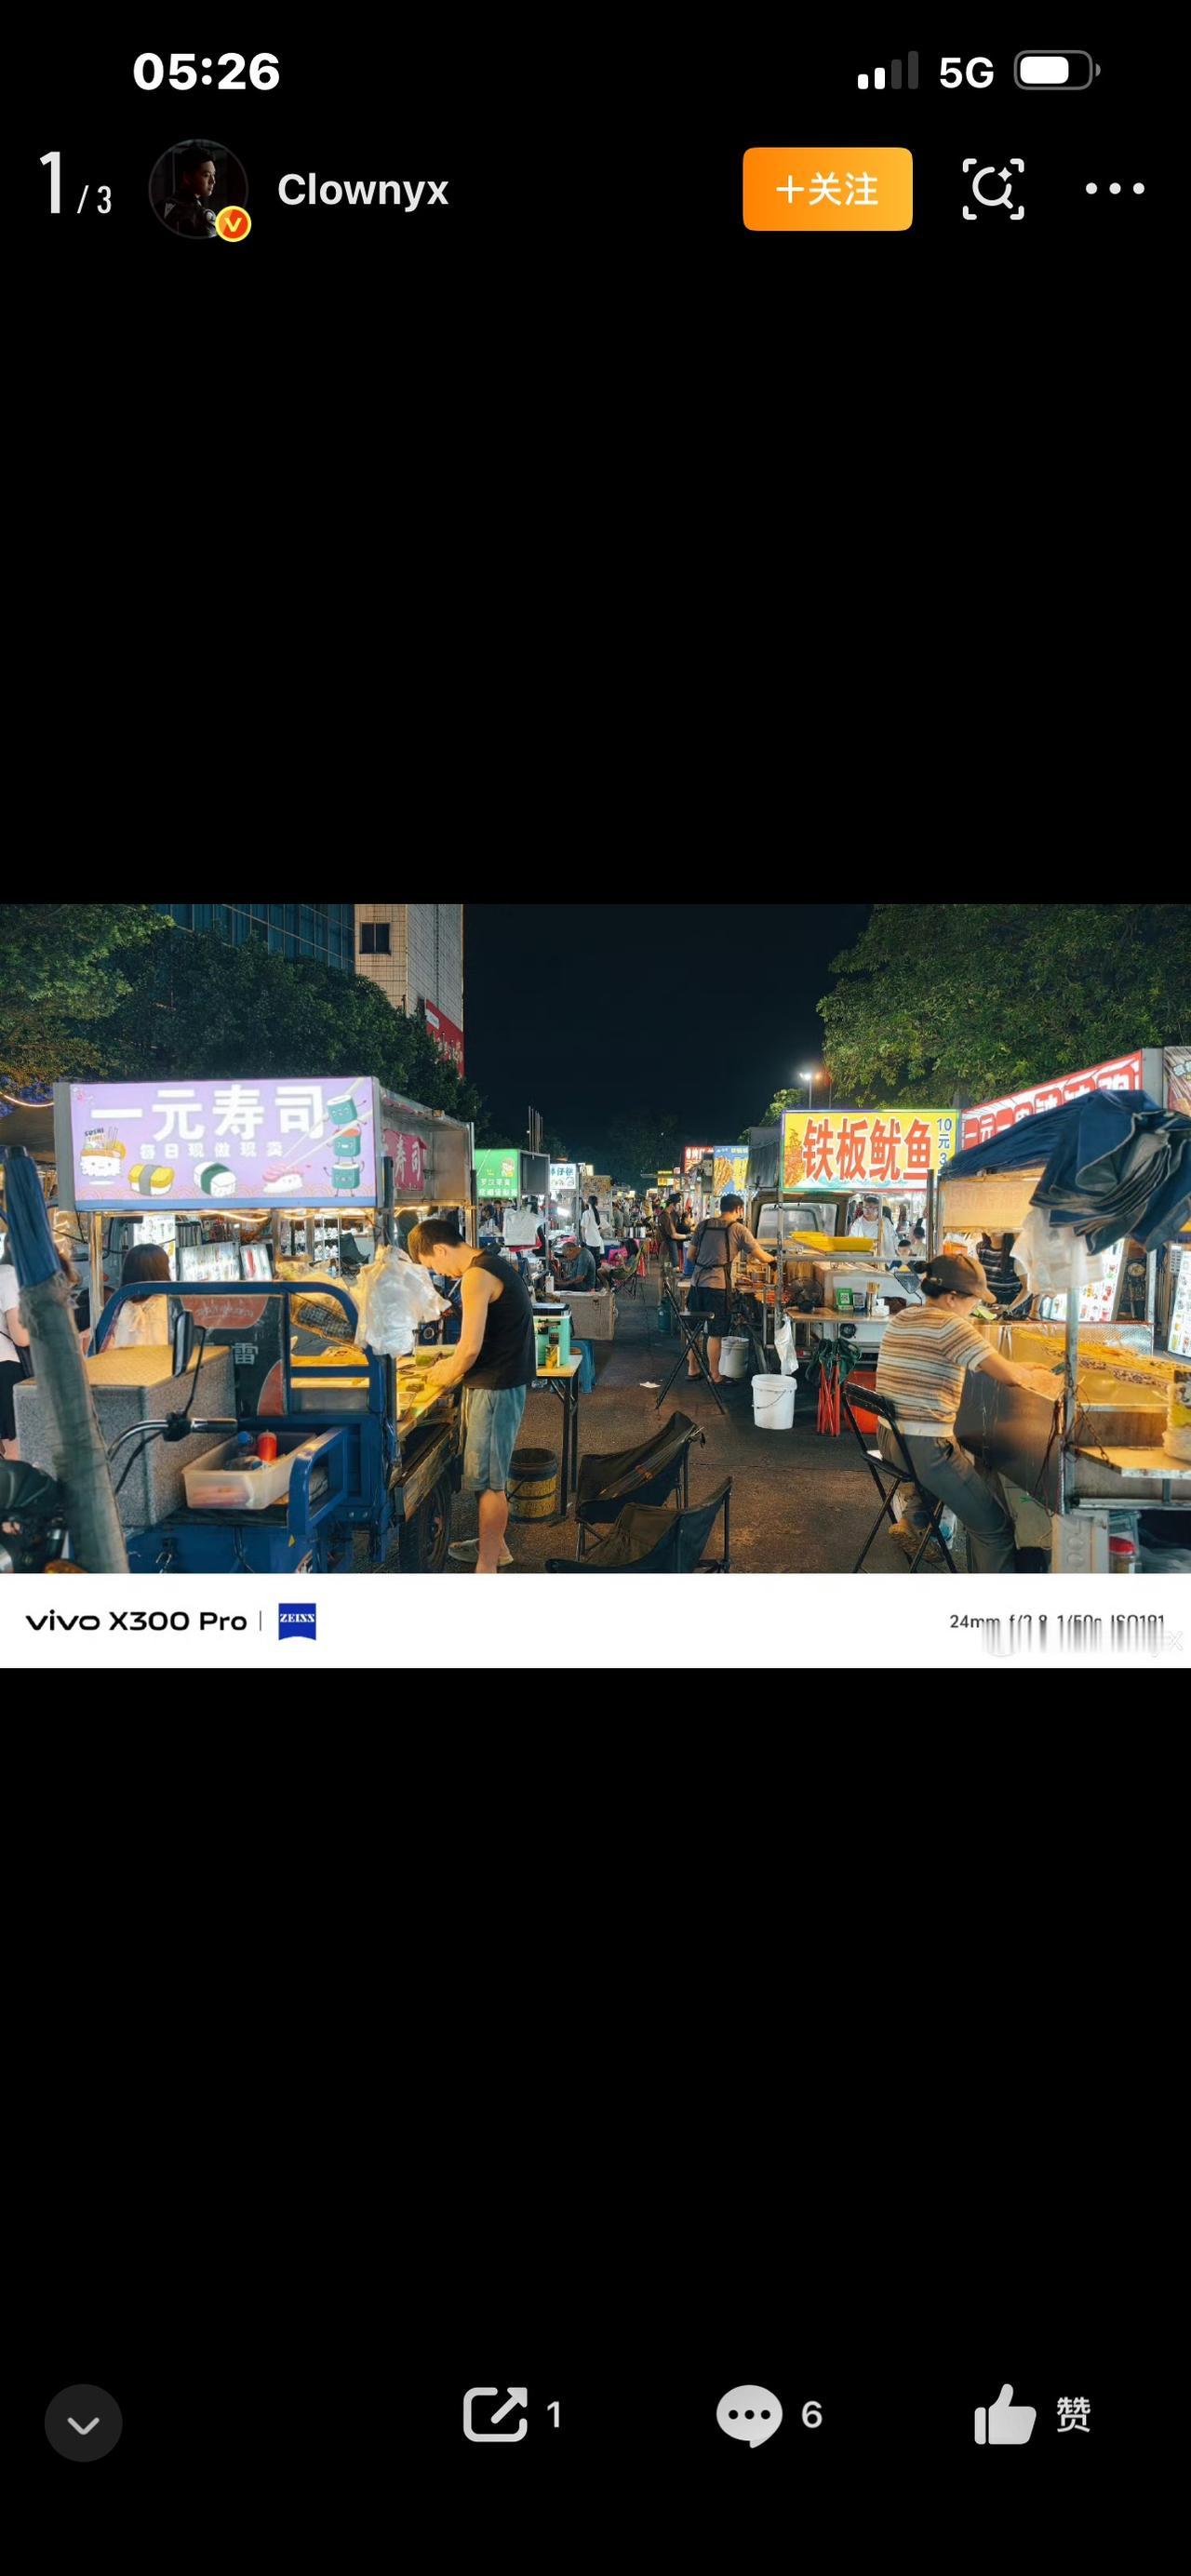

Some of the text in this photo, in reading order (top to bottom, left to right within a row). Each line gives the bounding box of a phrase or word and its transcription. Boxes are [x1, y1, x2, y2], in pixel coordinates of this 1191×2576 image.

[90, 1084, 324, 1141] 一元寿司
[140, 1141, 283, 1160] 每日现做现卖
[395, 1134, 422, 1182] 寿司
[802, 1117, 931, 1181] 铁板鱿鱼
